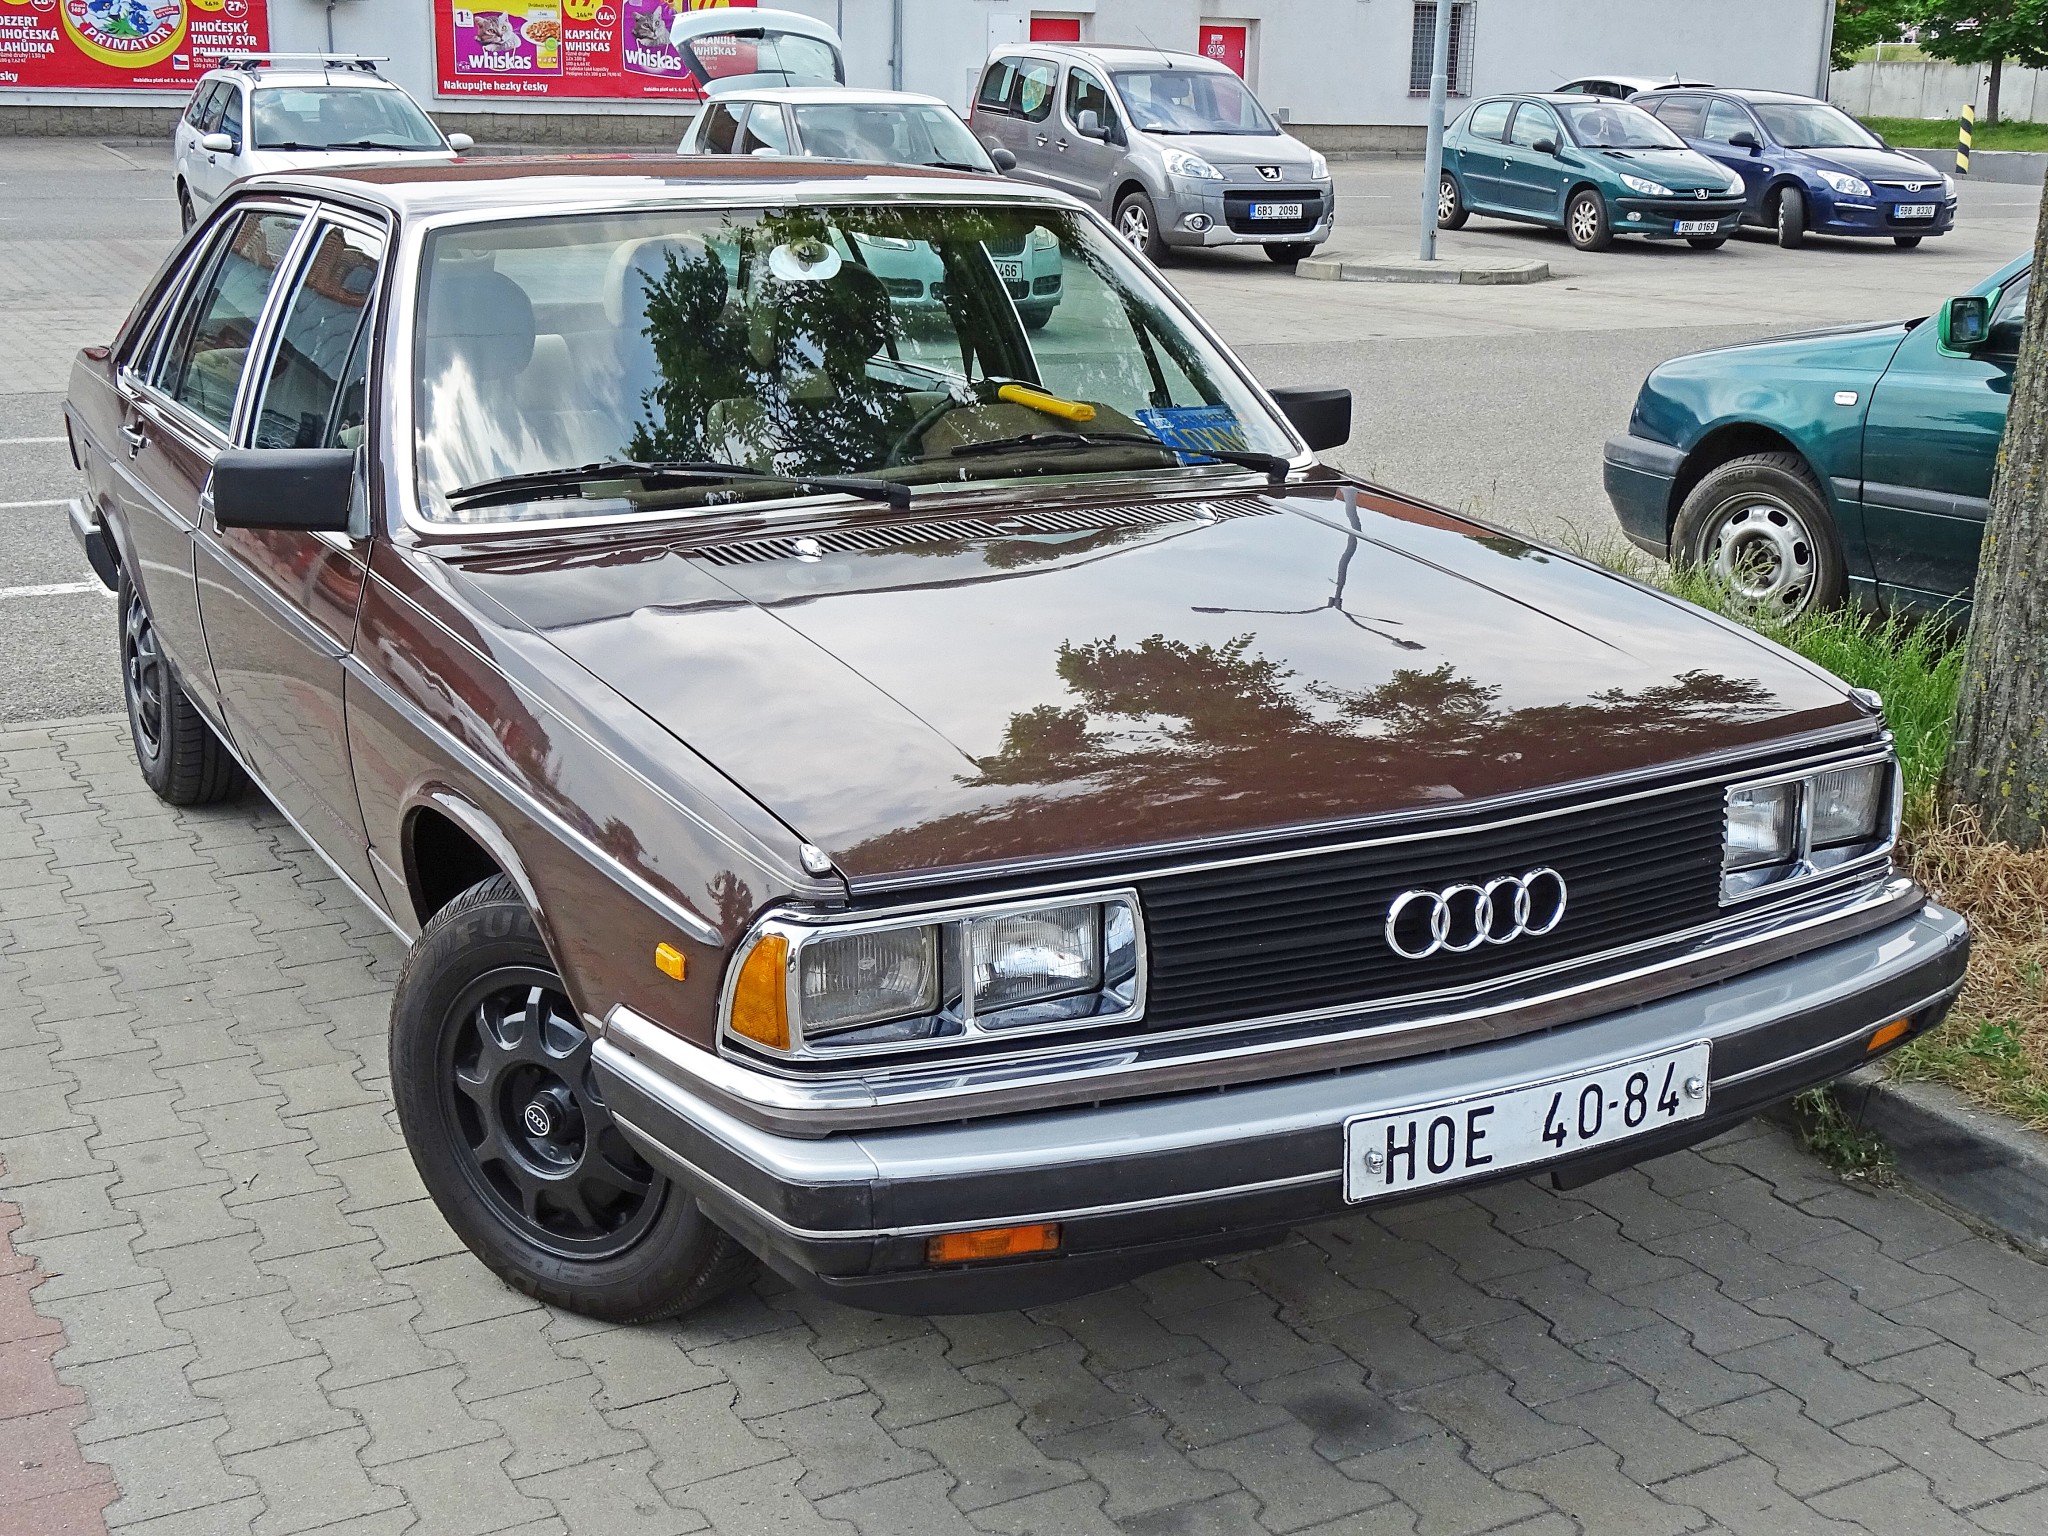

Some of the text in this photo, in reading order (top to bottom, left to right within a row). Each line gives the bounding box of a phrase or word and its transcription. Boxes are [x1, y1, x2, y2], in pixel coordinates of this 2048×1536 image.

[0, 26, 59, 40] IHOČESKÁ
[191, 20, 248, 33] JIHOČESKÝ
[84, 27, 171, 51] PRIMATOR
[191, 33, 257, 46] TAVENÝ SÝR
[565, 28, 612, 40] KAPSIČKY
[565, 42, 610, 51] WHISKAS
[694, 47, 736, 56] WHISKAS
[469, 52, 532, 69] whiskas
[625, 48, 681, 70] whiskas
[443, 80, 548, 92] Nakupujte hezky česky
[1257, 205, 1299, 216] 6B3 2099
[1681, 222, 1715, 231] 1BU 0169
[995, 264, 1017, 277] 466
[1385, 1061, 1680, 1185] HOE 40-84
